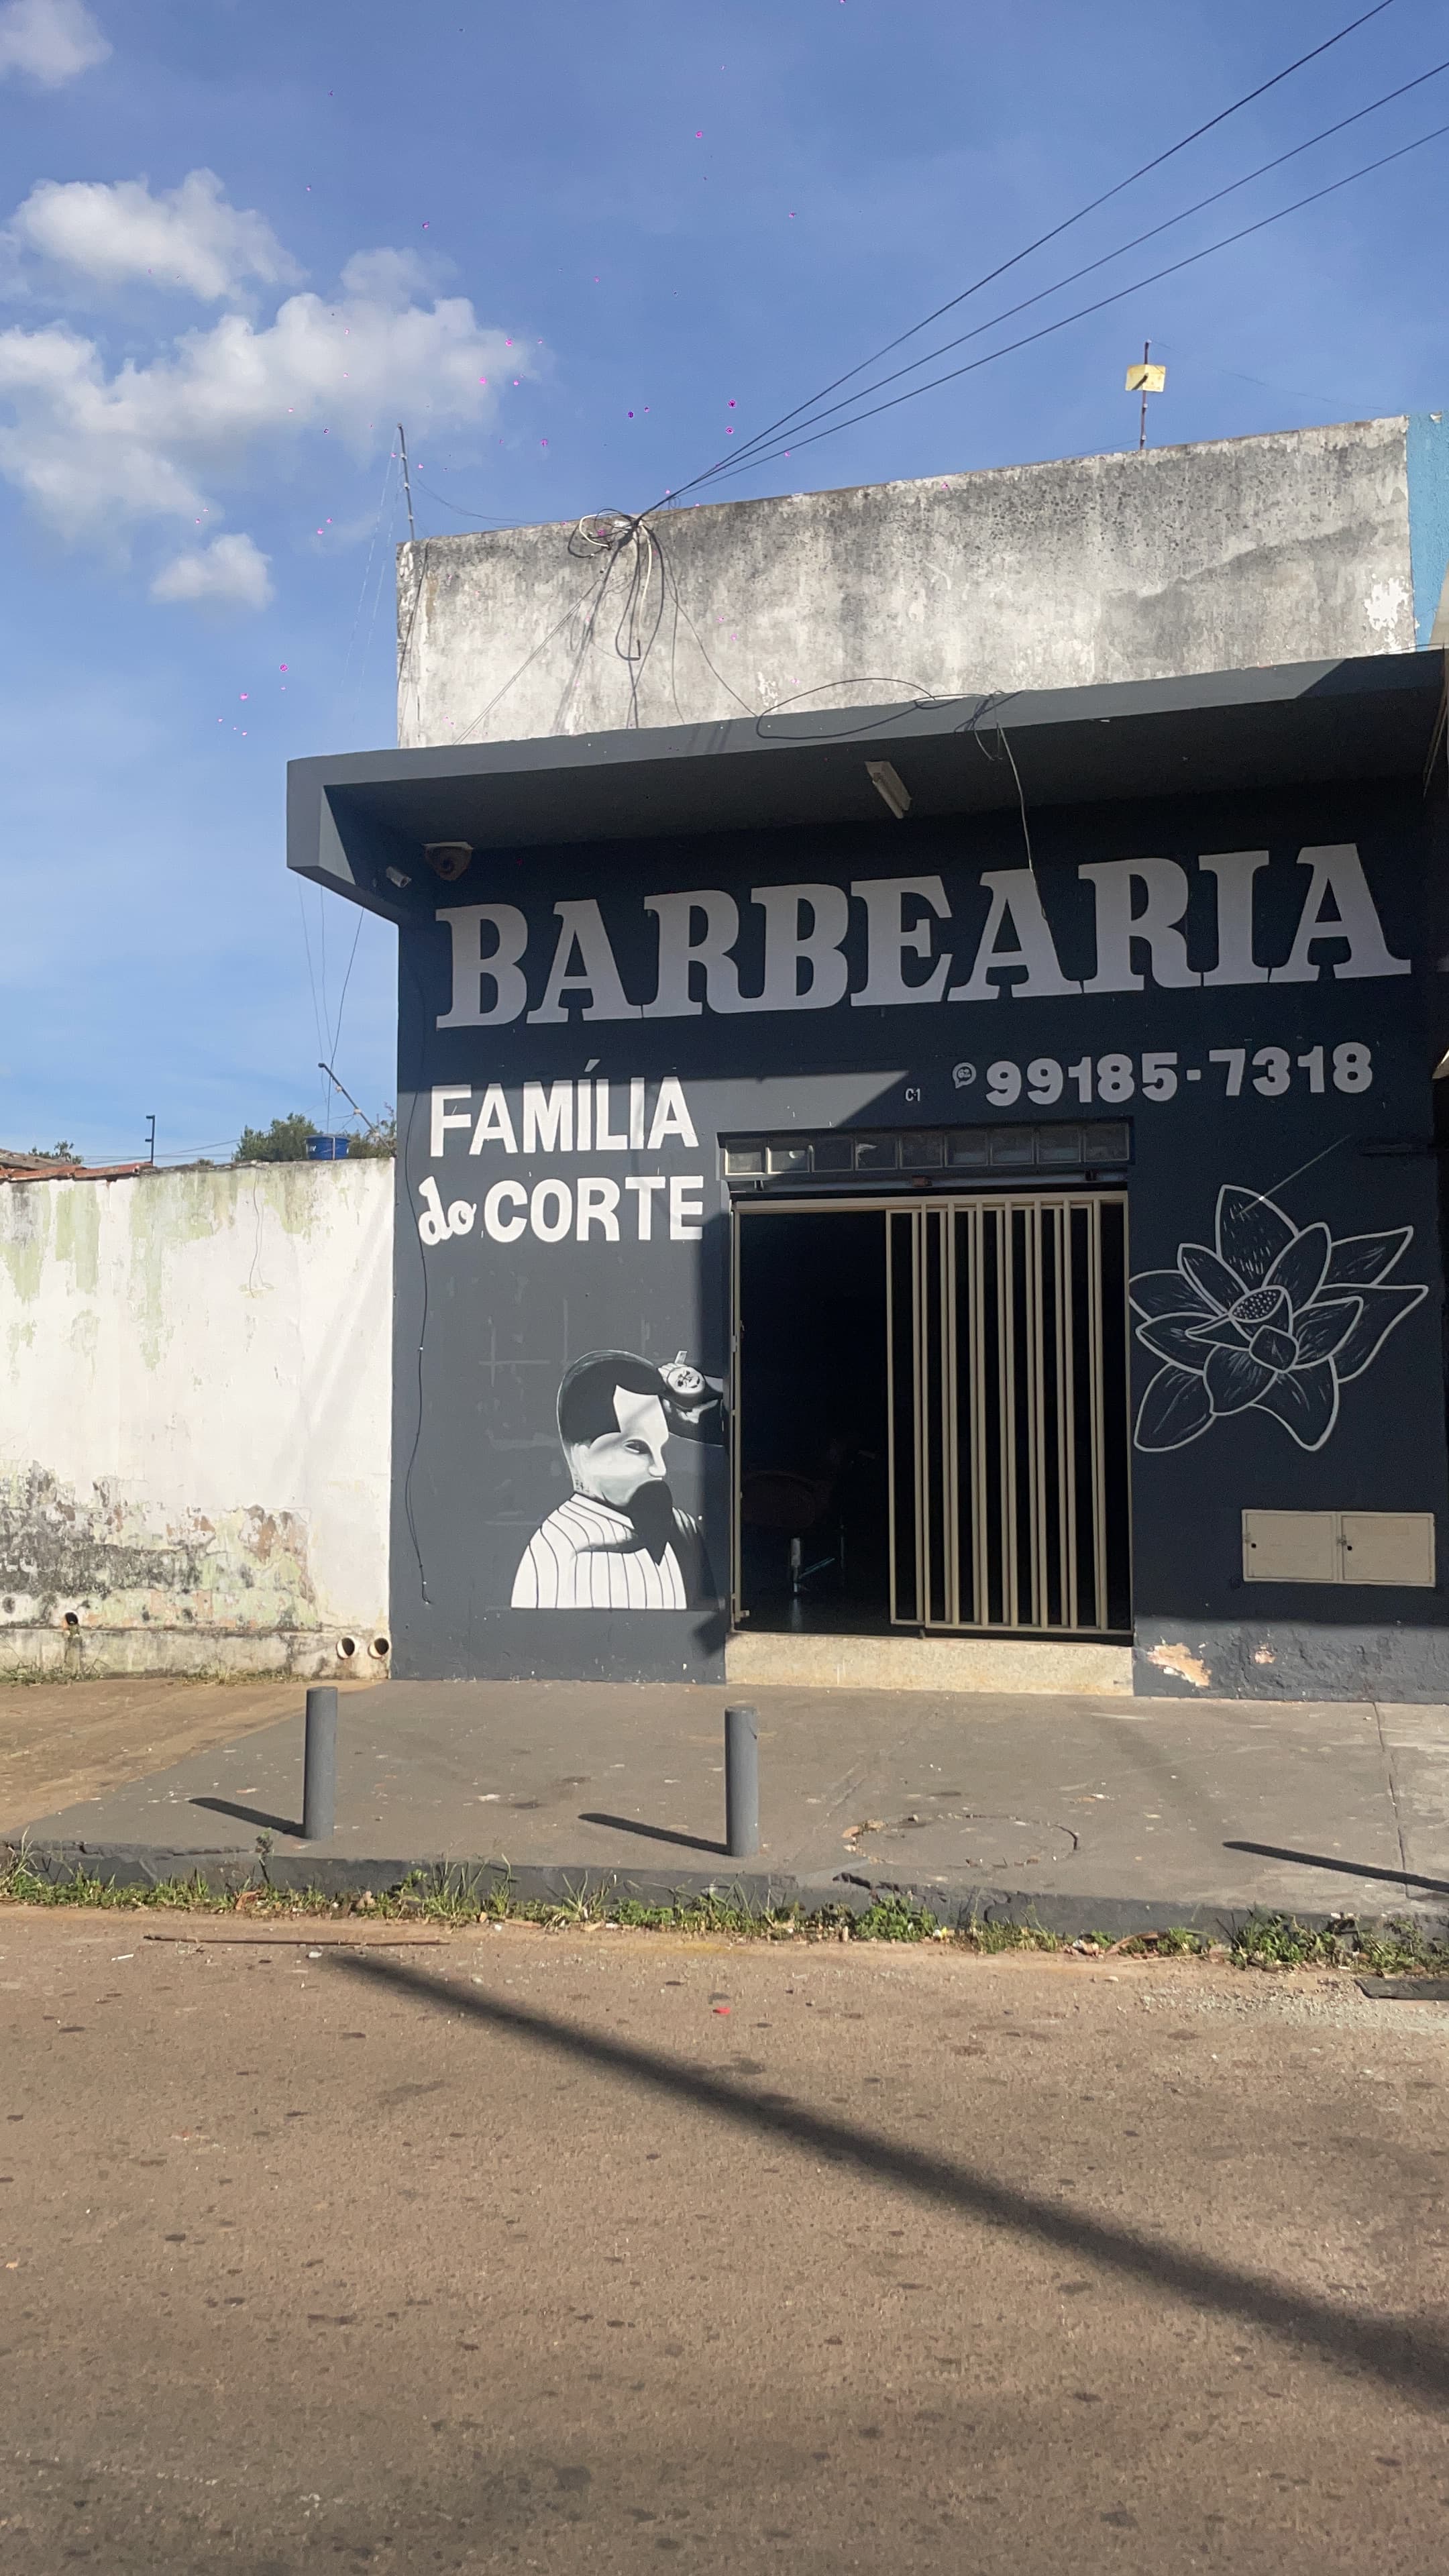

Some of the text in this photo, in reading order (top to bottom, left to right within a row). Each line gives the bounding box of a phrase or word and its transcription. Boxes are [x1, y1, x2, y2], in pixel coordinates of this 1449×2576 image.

[435, 843, 1411, 1030] BARBEARIA
[430, 1059, 699, 1157] FAMÍLIA
[985, 1042, 1373, 1107] 99185-7318
[419, 1175, 704, 1246] do CORTE
